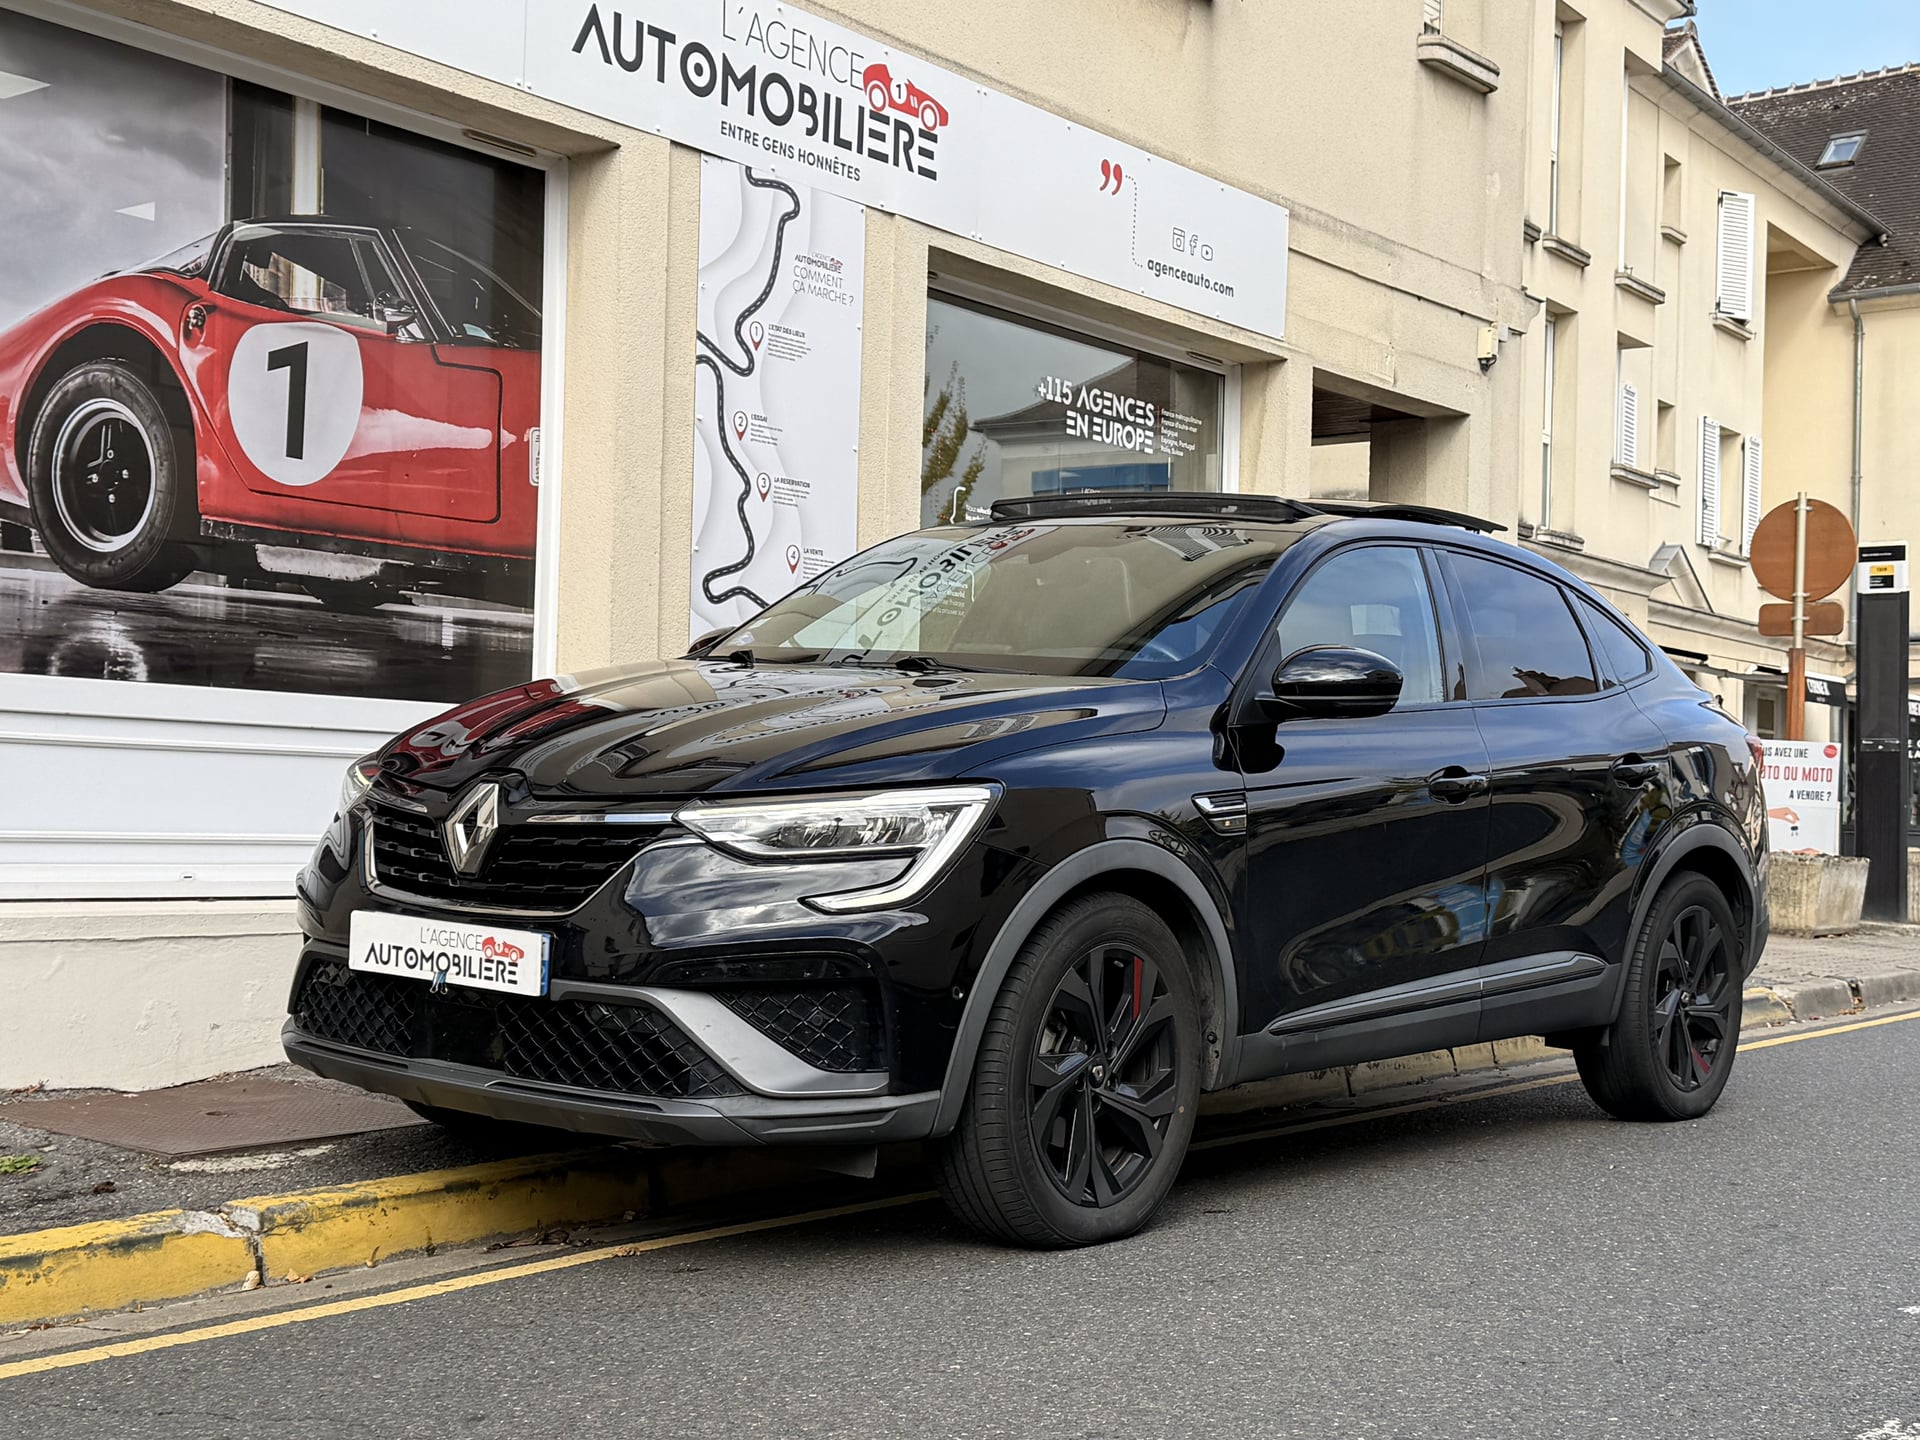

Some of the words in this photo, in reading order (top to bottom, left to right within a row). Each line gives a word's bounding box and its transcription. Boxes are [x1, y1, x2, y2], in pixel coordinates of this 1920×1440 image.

[723, 0, 864, 90] L'AGENCE
[571, 3, 938, 181] AUTOMOBILIERE
[720, 121, 759, 147] ENTRE
[762, 136, 794, 160] GENS
[798, 149, 861, 182] HONNÊTES
[793, 265, 843, 289] COMMENT
[1147, 258, 1234, 307] agenceauto.com
[793, 279, 805, 294] ÇA
[807, 284, 847, 305] MARCHE
[849, 296, 854, 306] ?
[754, 326, 758, 337] 1
[267, 341, 309, 461] 1
[1037, 376, 1072, 405] +115
[1076, 386, 1154, 427] AGENCES
[738, 416, 743, 427] 2
[1066, 410, 1088, 438] EN
[1093, 416, 1154, 454] EUROPE
[761, 477, 766, 488] 3
[790, 551, 796, 560] 4
[1774, 748, 1791, 757] AVEZ
[1794, 748, 1808, 758] UNE
[1783, 766, 1798, 781] OU
[1801, 767, 1832, 782] MOTO
[1789, 790, 1794, 799] A
[1796, 790, 1824, 801] VENDRE
[1827, 791, 1832, 801] ?
[420, 926, 482, 952] L'AGENCE
[364, 942, 518, 985] AUTOMOBILIERE
